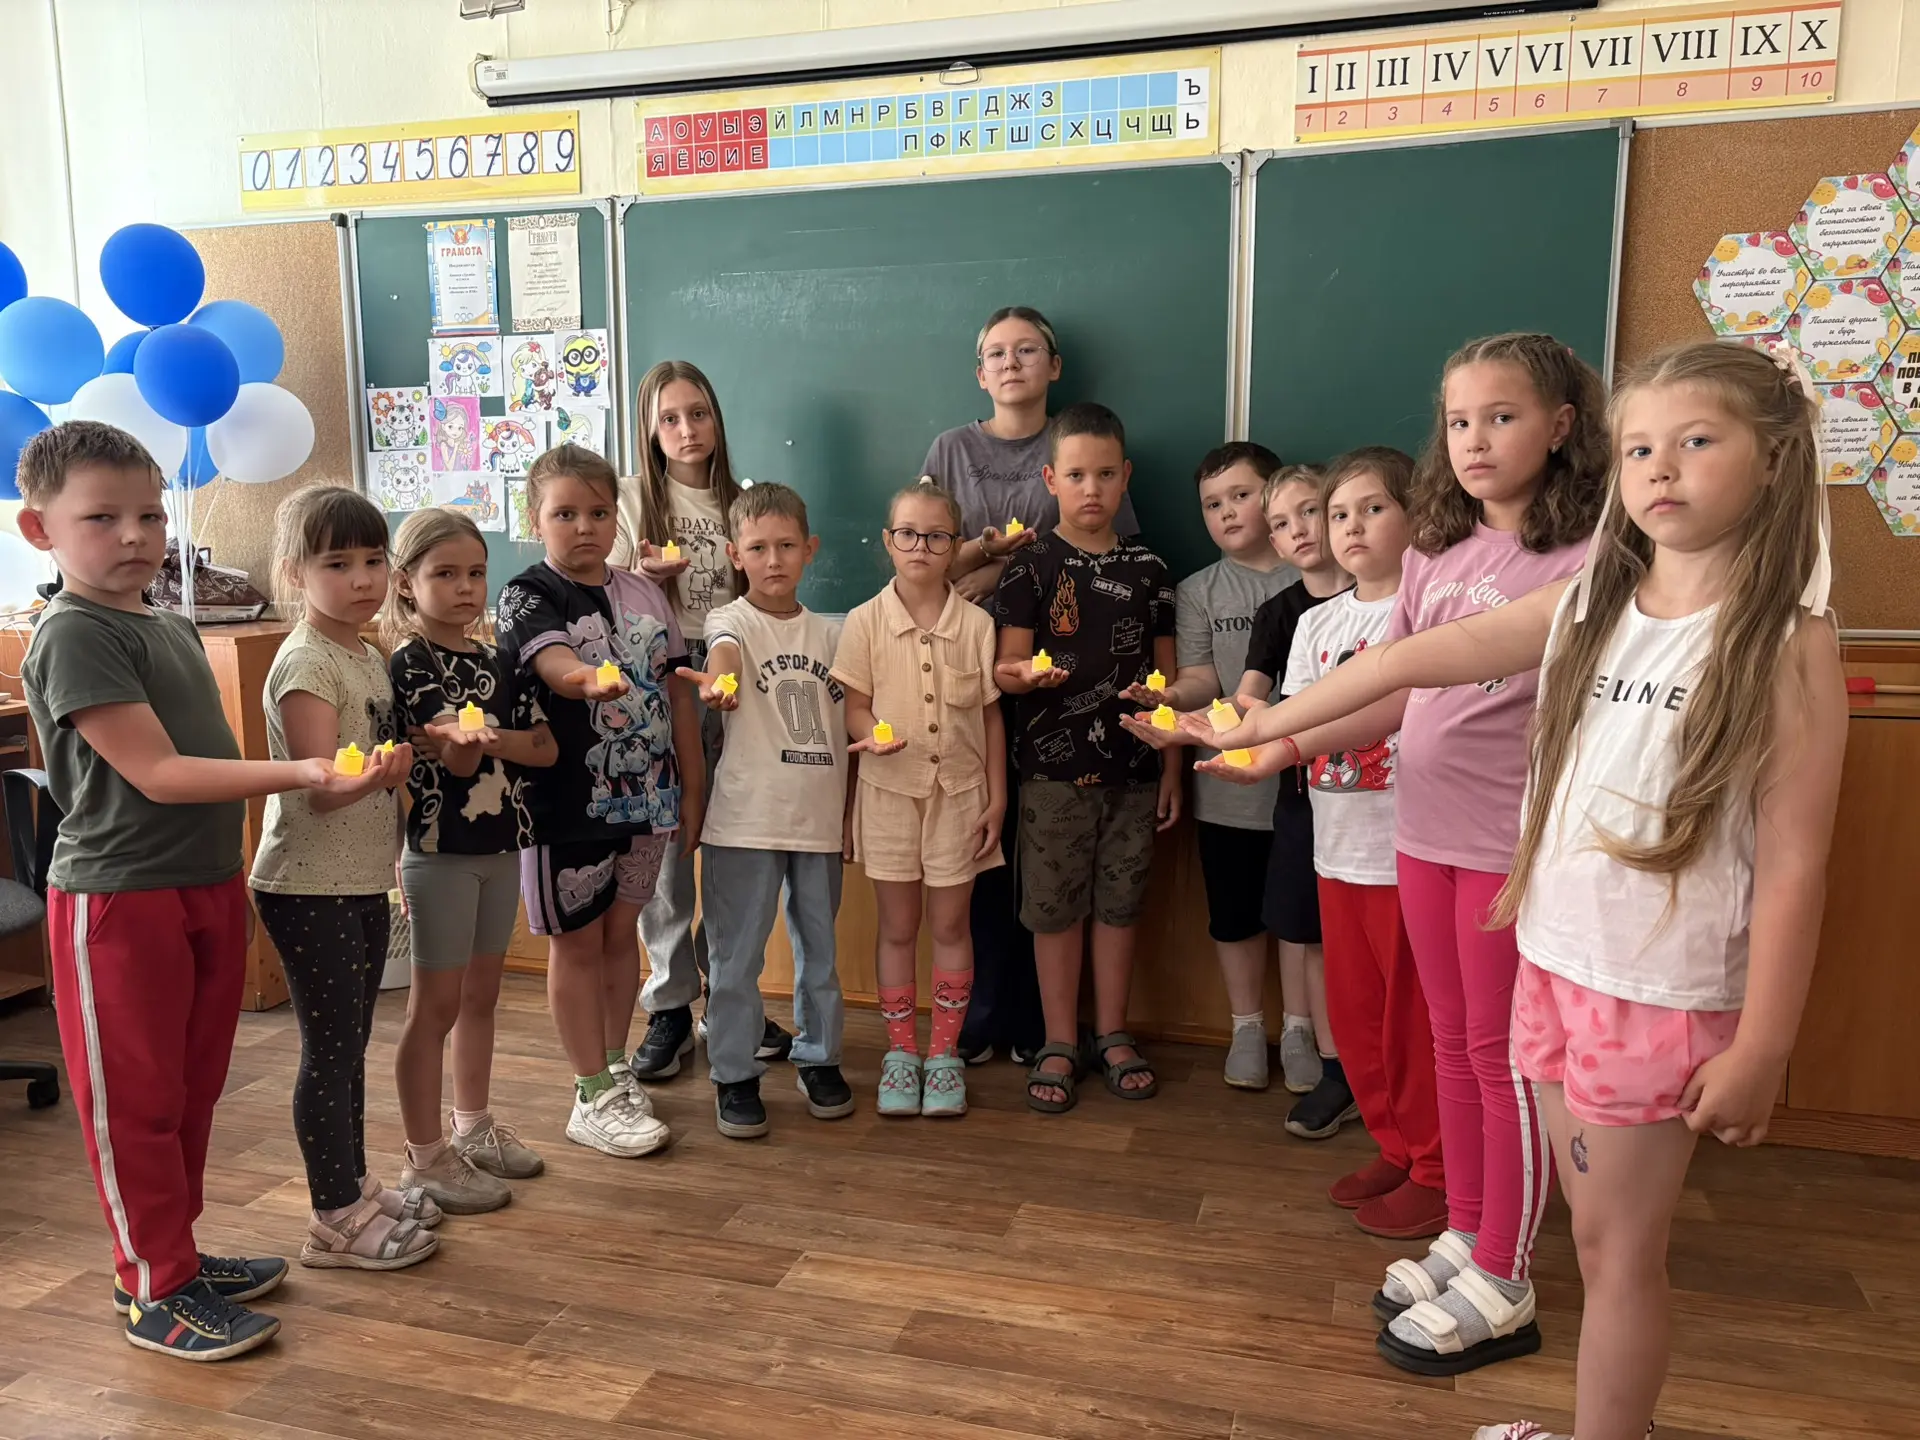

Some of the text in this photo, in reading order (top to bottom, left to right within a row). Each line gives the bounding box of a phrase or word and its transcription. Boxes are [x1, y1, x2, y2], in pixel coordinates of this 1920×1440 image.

[1308, 19, 1828, 93] I II III IV V VI VII VIII IX X
[1304, 72, 1822, 127] 1 2 3 4 5 6 7 8 9 10
[651, 79, 1200, 140] А О У Ы Э Й Л М Н Р Б В Г Д Ж З Ъ
[652, 113, 1199, 171] Я Ё Ю И Е П Ф К Т Ш С Х Ц Ч Щ Ь
[252, 129, 575, 190] 0 1 2 3 4 5 6 7 8 9
[1820, 206, 1844, 215] Следи
[1860, 203, 1882, 211] своей
[1815, 216, 1877, 225] безопасностью
[1819, 226, 1880, 236] безопасностью
[1822, 239, 1877, 249] окружающих
[441, 246, 483, 257] ГРАМОТА
[1716, 268, 1755, 278] Участвуй
[1770, 267, 1787, 275] всех
[1720, 279, 1781, 289] мероприятиях
[1733, 290, 1776, 298] занятиях
[1808, 316, 1878, 325] Помогай другим
[1838, 327, 1856, 336] будь
[1812, 338, 1871, 348] дружелюбным
[1902, 382, 1912, 394] В
[681, 517, 710, 530] DAY
